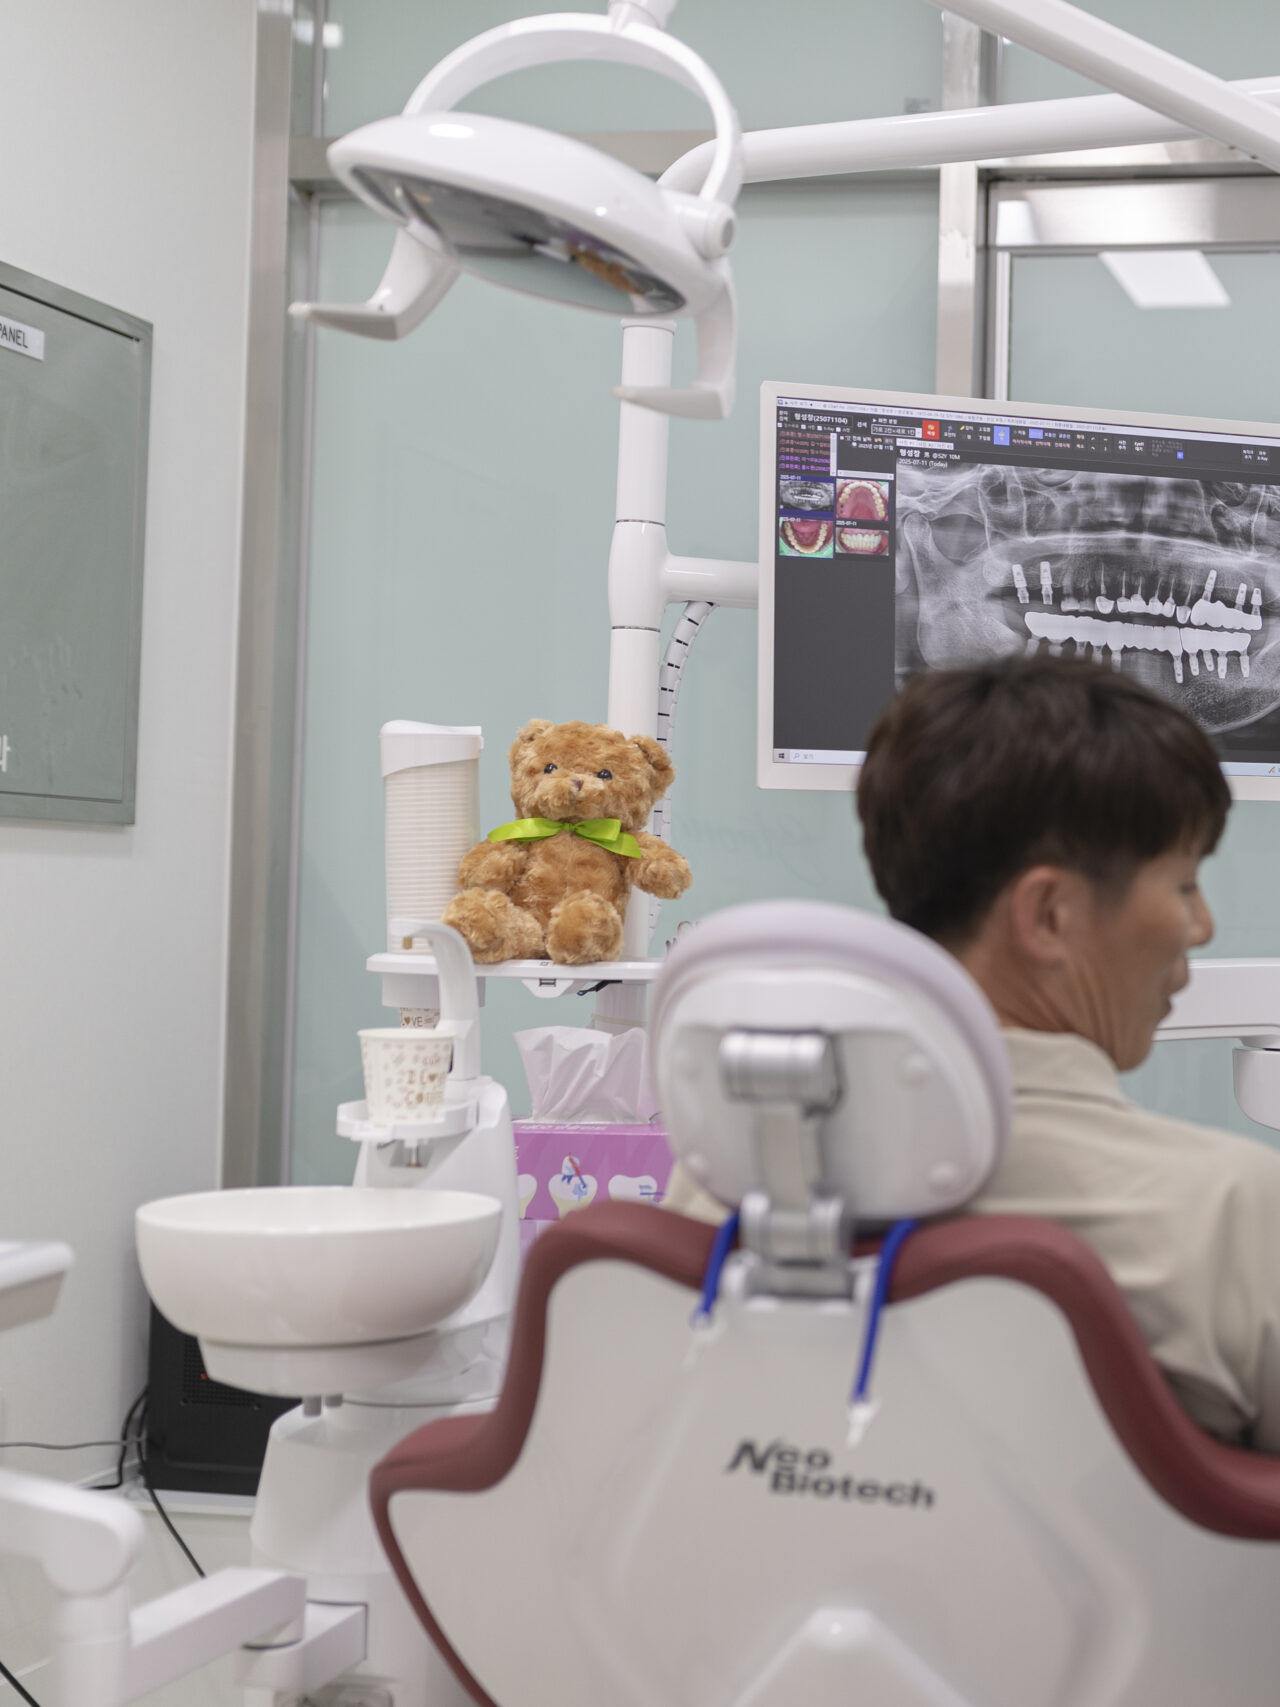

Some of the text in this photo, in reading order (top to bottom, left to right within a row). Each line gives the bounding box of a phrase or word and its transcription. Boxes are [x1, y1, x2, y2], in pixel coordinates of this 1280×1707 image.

[899, 459, 948, 468] 2025-07-11 (Today)
[725, 1440, 830, 1472] Neo
[771, 1472, 934, 1507] Biotech
